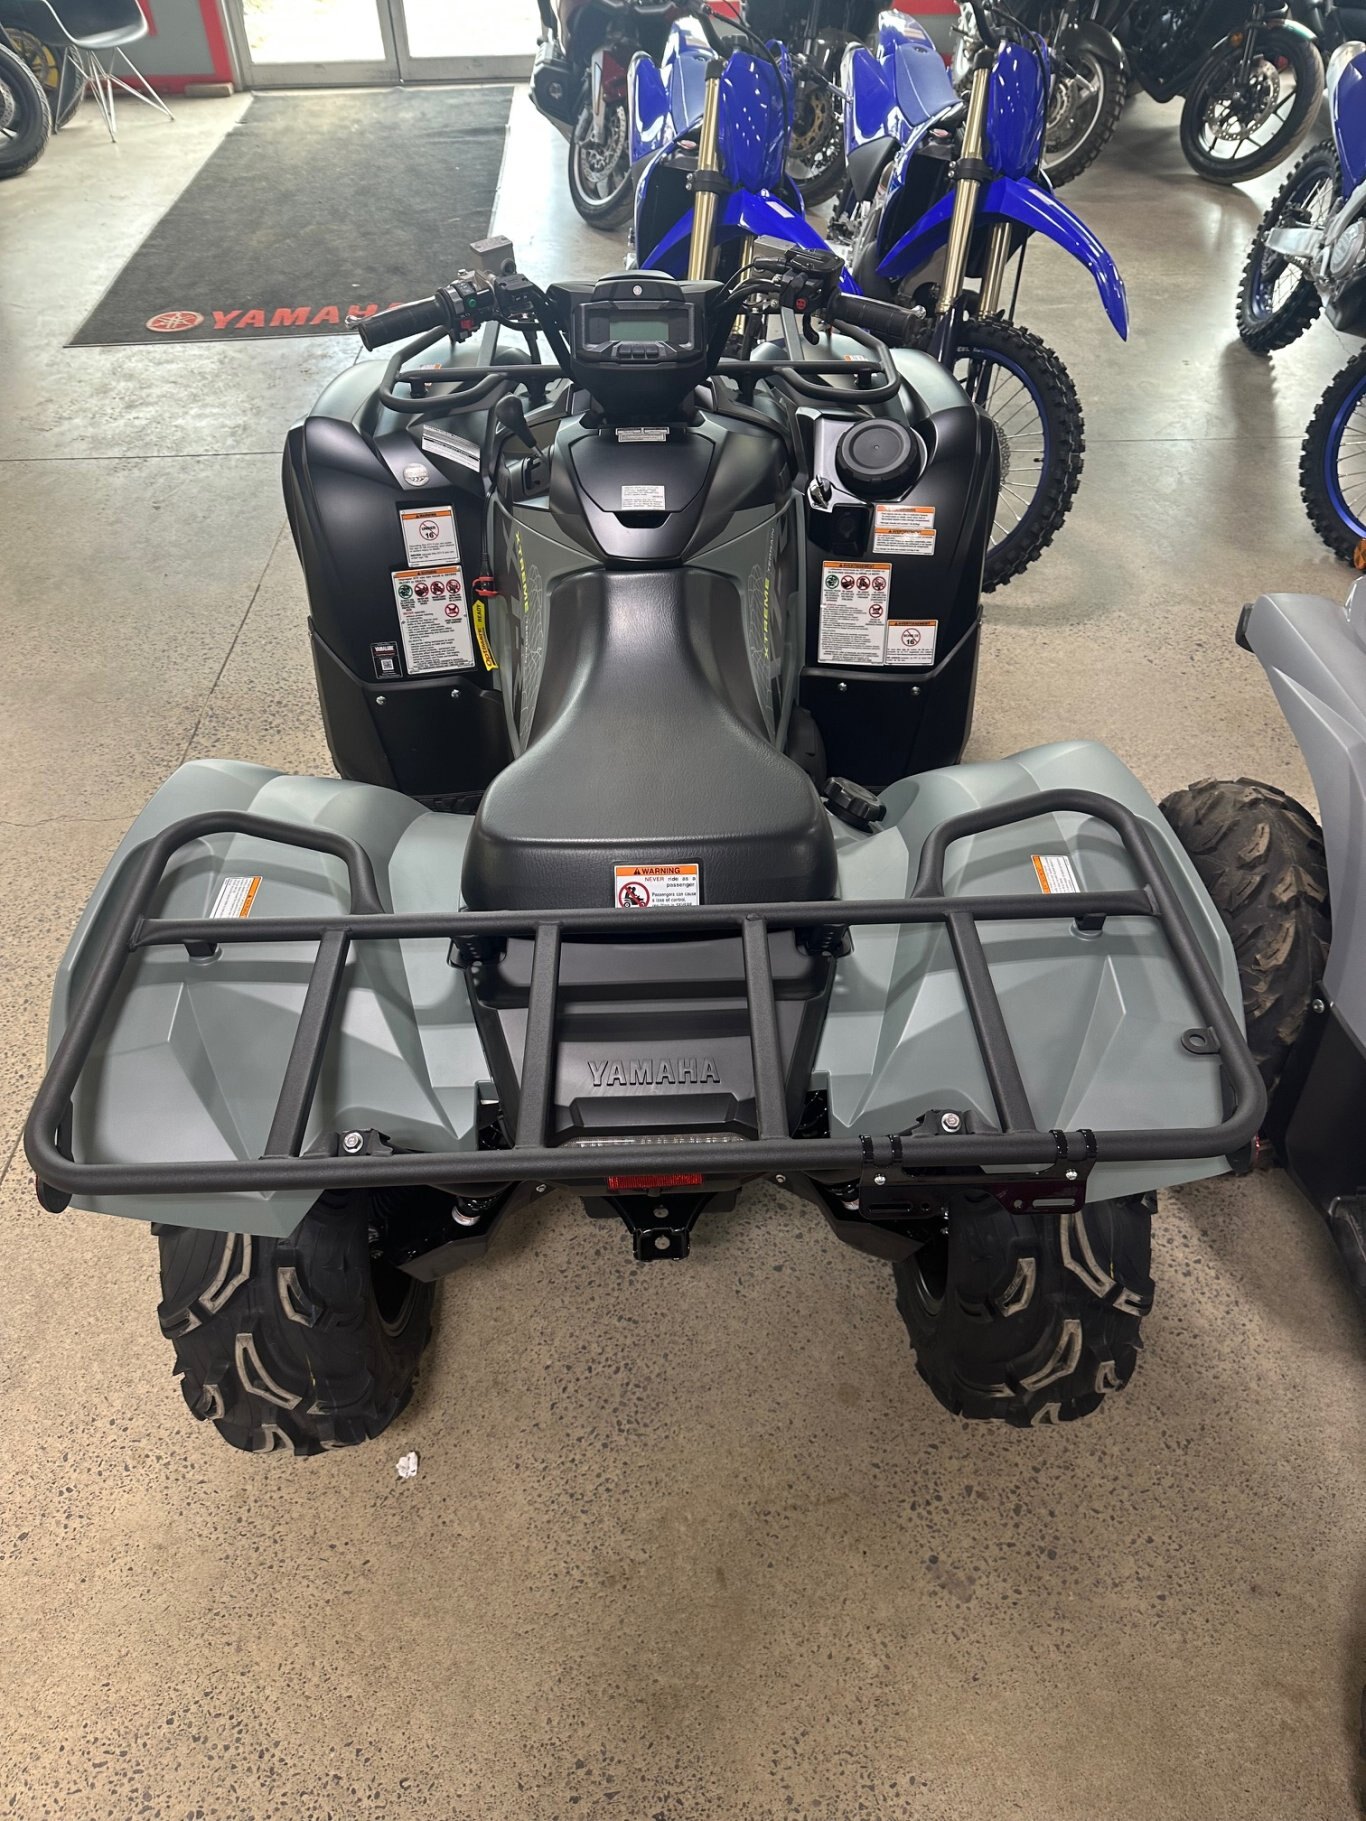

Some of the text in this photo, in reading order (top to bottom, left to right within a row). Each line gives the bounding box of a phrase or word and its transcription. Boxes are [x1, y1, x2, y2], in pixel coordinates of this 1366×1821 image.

[516, 531, 529, 613] XTREME
[642, 867, 681, 875] WARNING
[587, 1056, 721, 1087] YAMAHA
